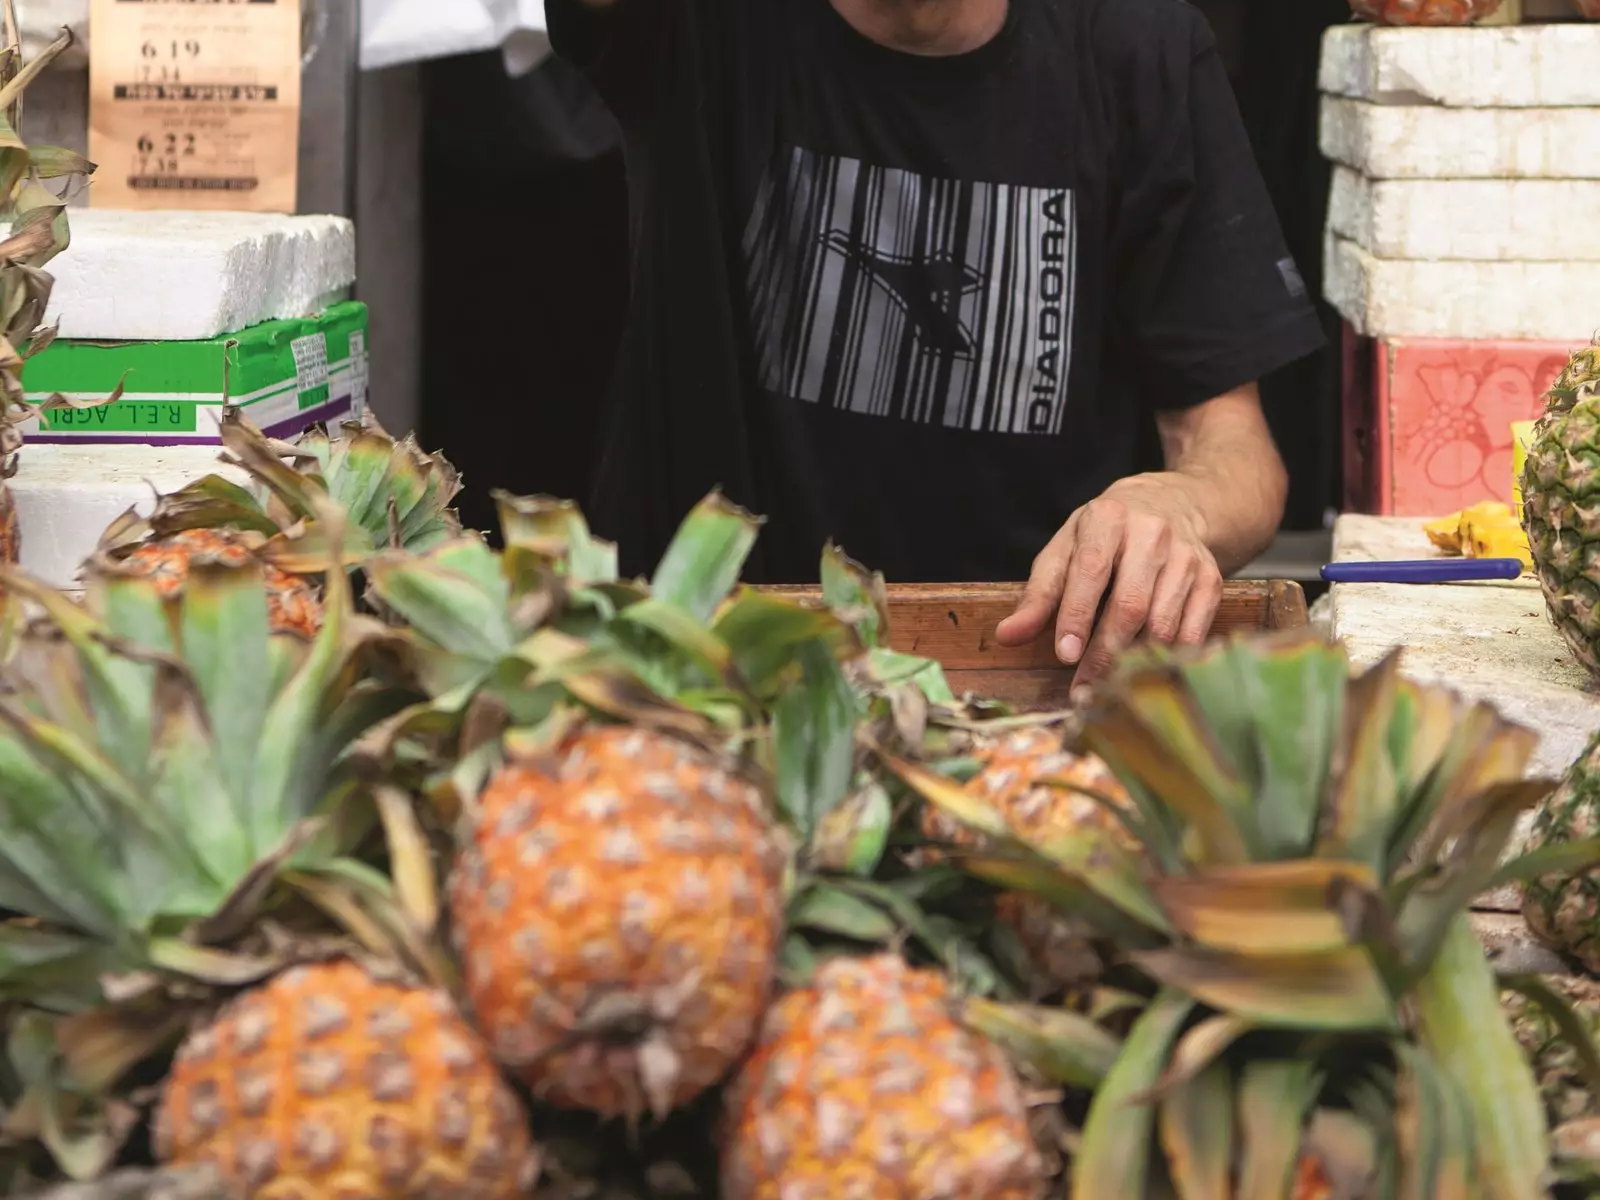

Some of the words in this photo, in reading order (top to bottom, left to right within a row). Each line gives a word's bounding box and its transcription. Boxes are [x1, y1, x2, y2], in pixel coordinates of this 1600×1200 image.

[1027, 190, 1067, 432] DIADORA
[53, 407, 109, 425] AGRI
[119, 405, 181, 425] R.E.L.
